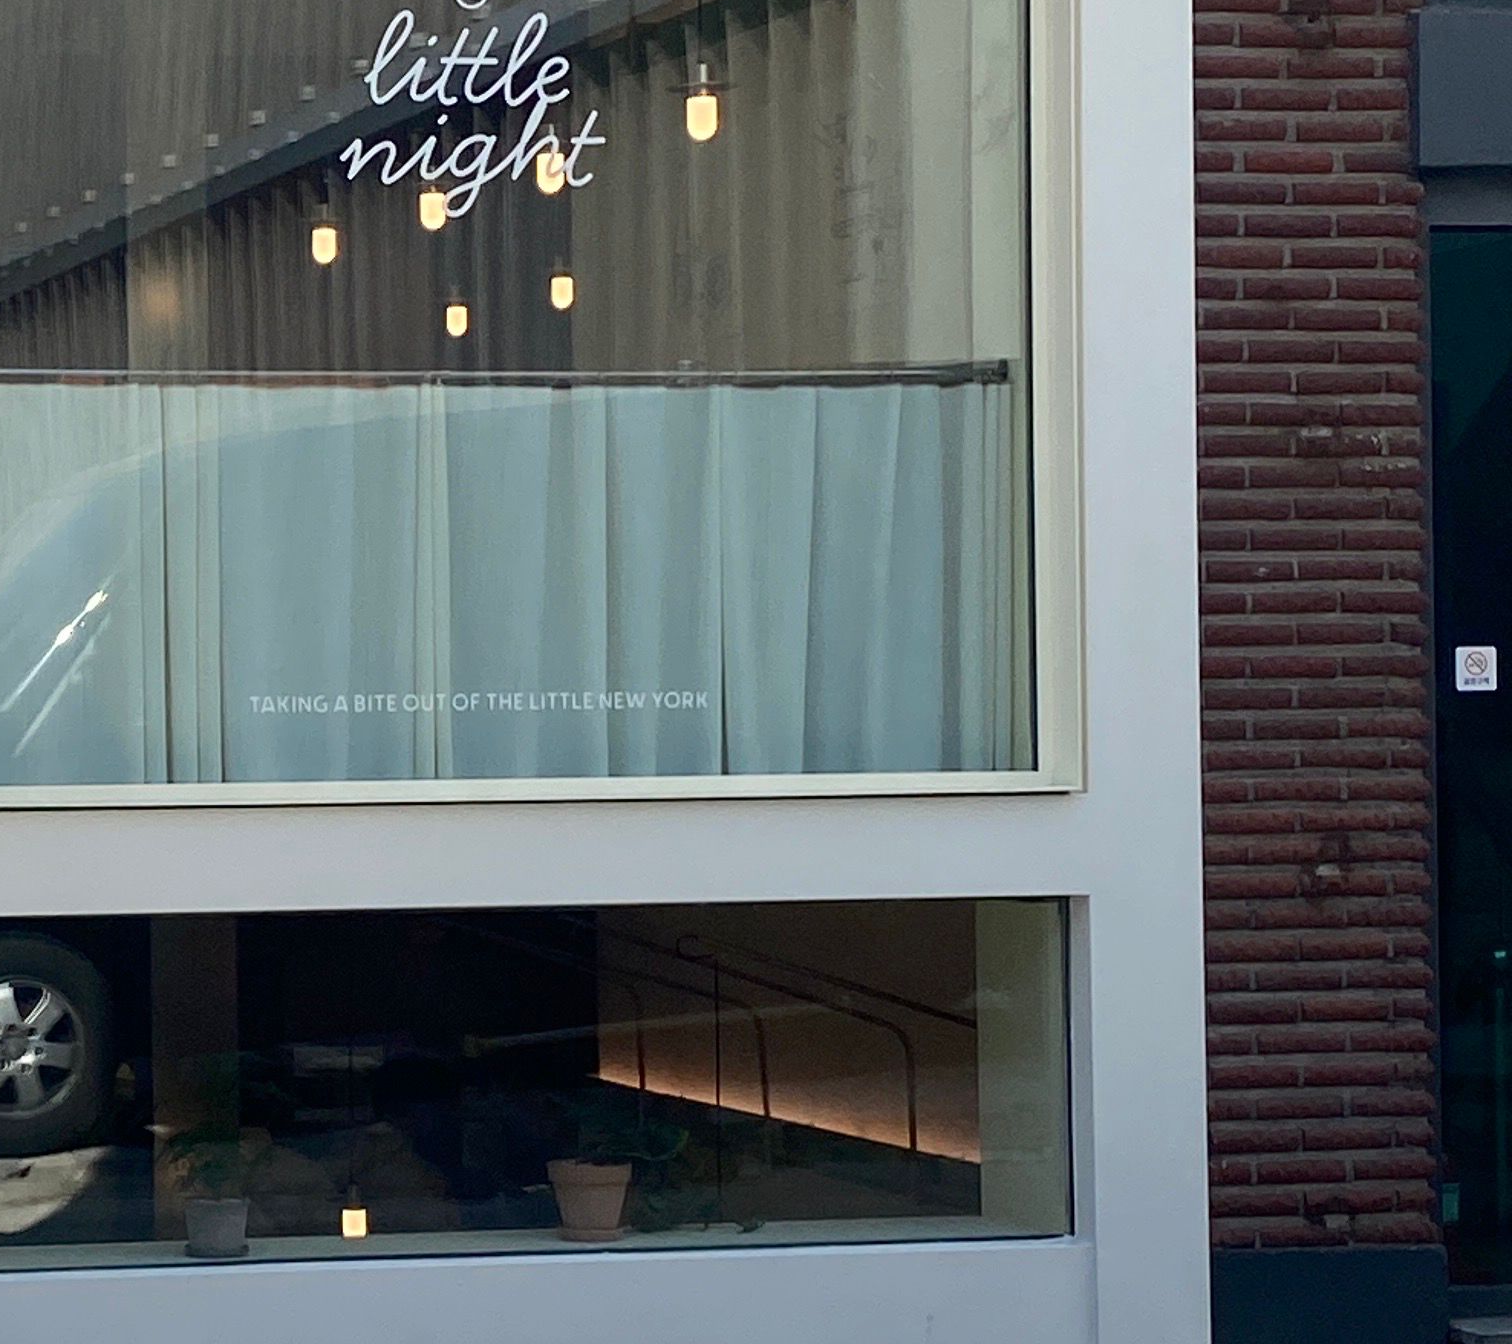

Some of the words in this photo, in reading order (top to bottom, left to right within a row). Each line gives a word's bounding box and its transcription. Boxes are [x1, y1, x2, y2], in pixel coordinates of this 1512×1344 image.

[364, 9, 571, 107] little
[339, 106, 607, 218] night
[249, 695, 329, 714] TAKING
[334, 695, 348, 713] A
[353, 693, 397, 713] BITE
[402, 693, 447, 713] OUT
[452, 692, 481, 712] OF
[487, 692, 524, 712] THE
[529, 691, 595, 711] LITTLE
[599, 691, 648, 710] NEW
[651, 690, 709, 709] YORK
